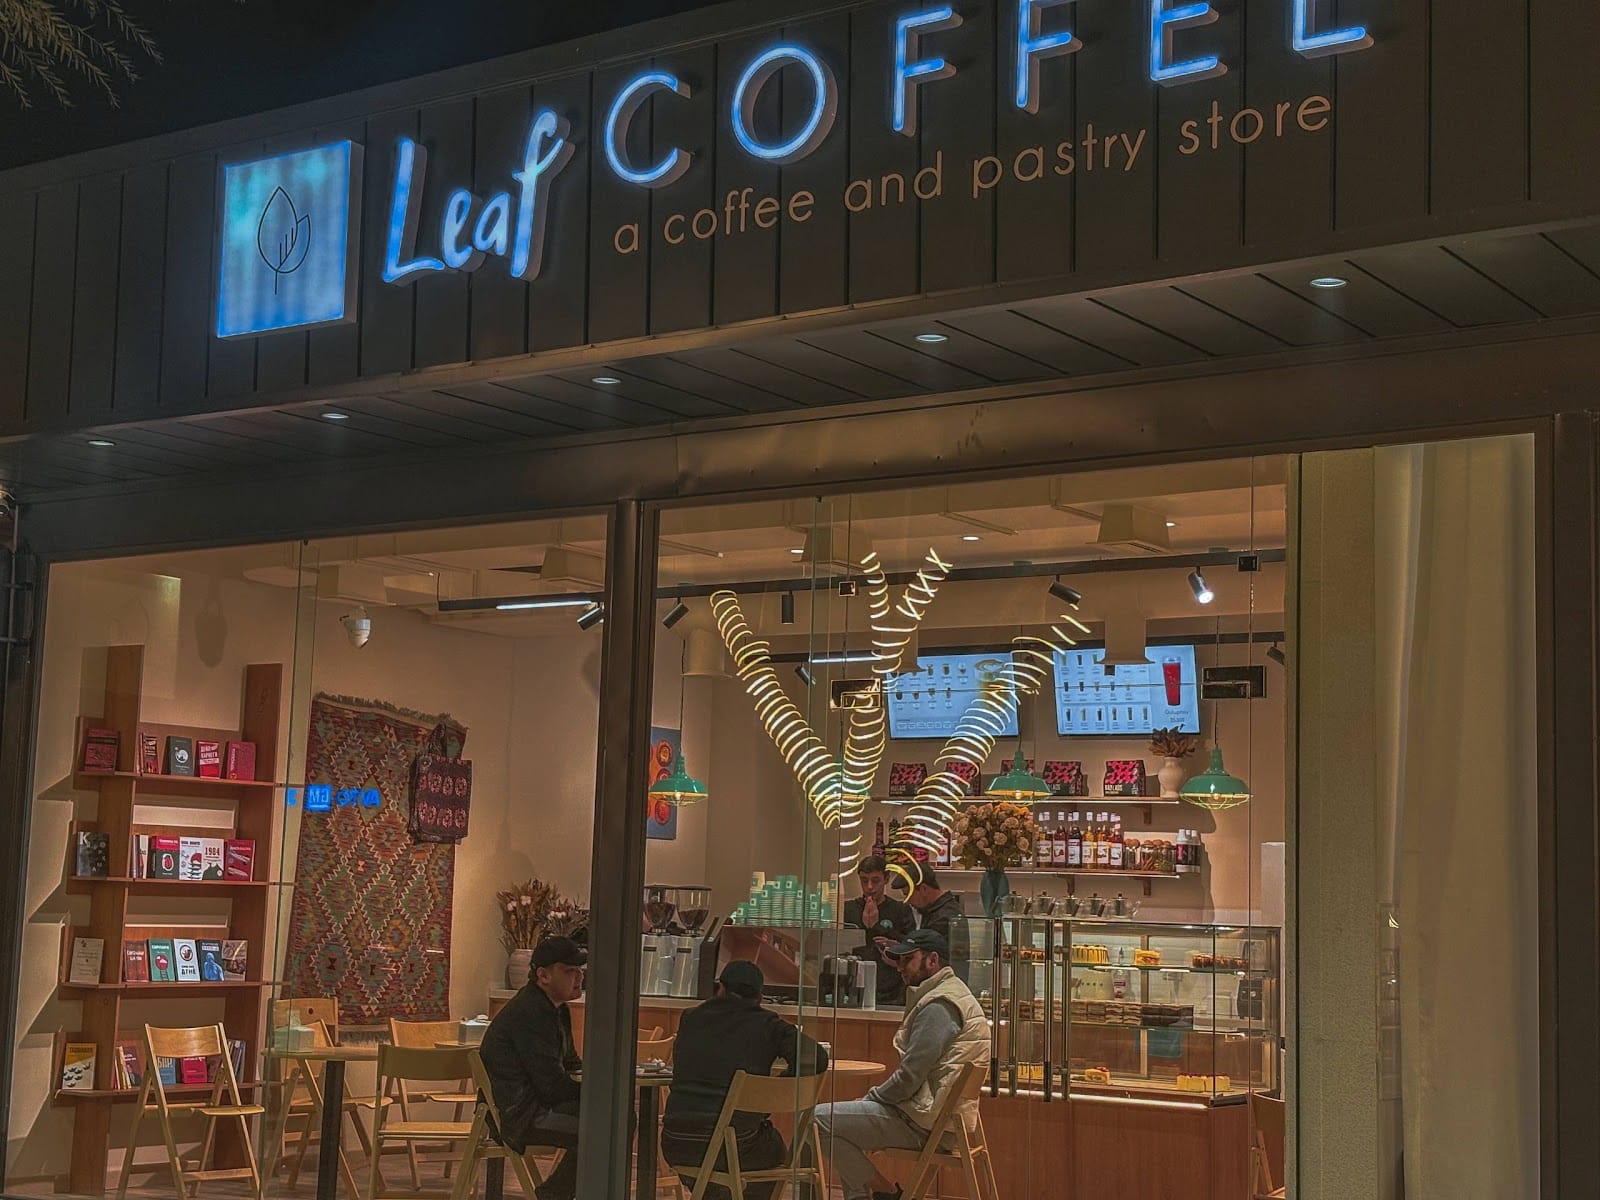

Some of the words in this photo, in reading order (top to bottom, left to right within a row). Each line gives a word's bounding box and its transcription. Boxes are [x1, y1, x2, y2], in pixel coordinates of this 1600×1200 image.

[382, 109, 572, 284] Leaf
[614, 222, 640, 254] a
[663, 187, 815, 245] coffee
[844, 150, 943, 212] and
[972, 123, 1146, 199] pastry
[1178, 100, 1331, 155] store
[204, 847, 221, 856] 1984
